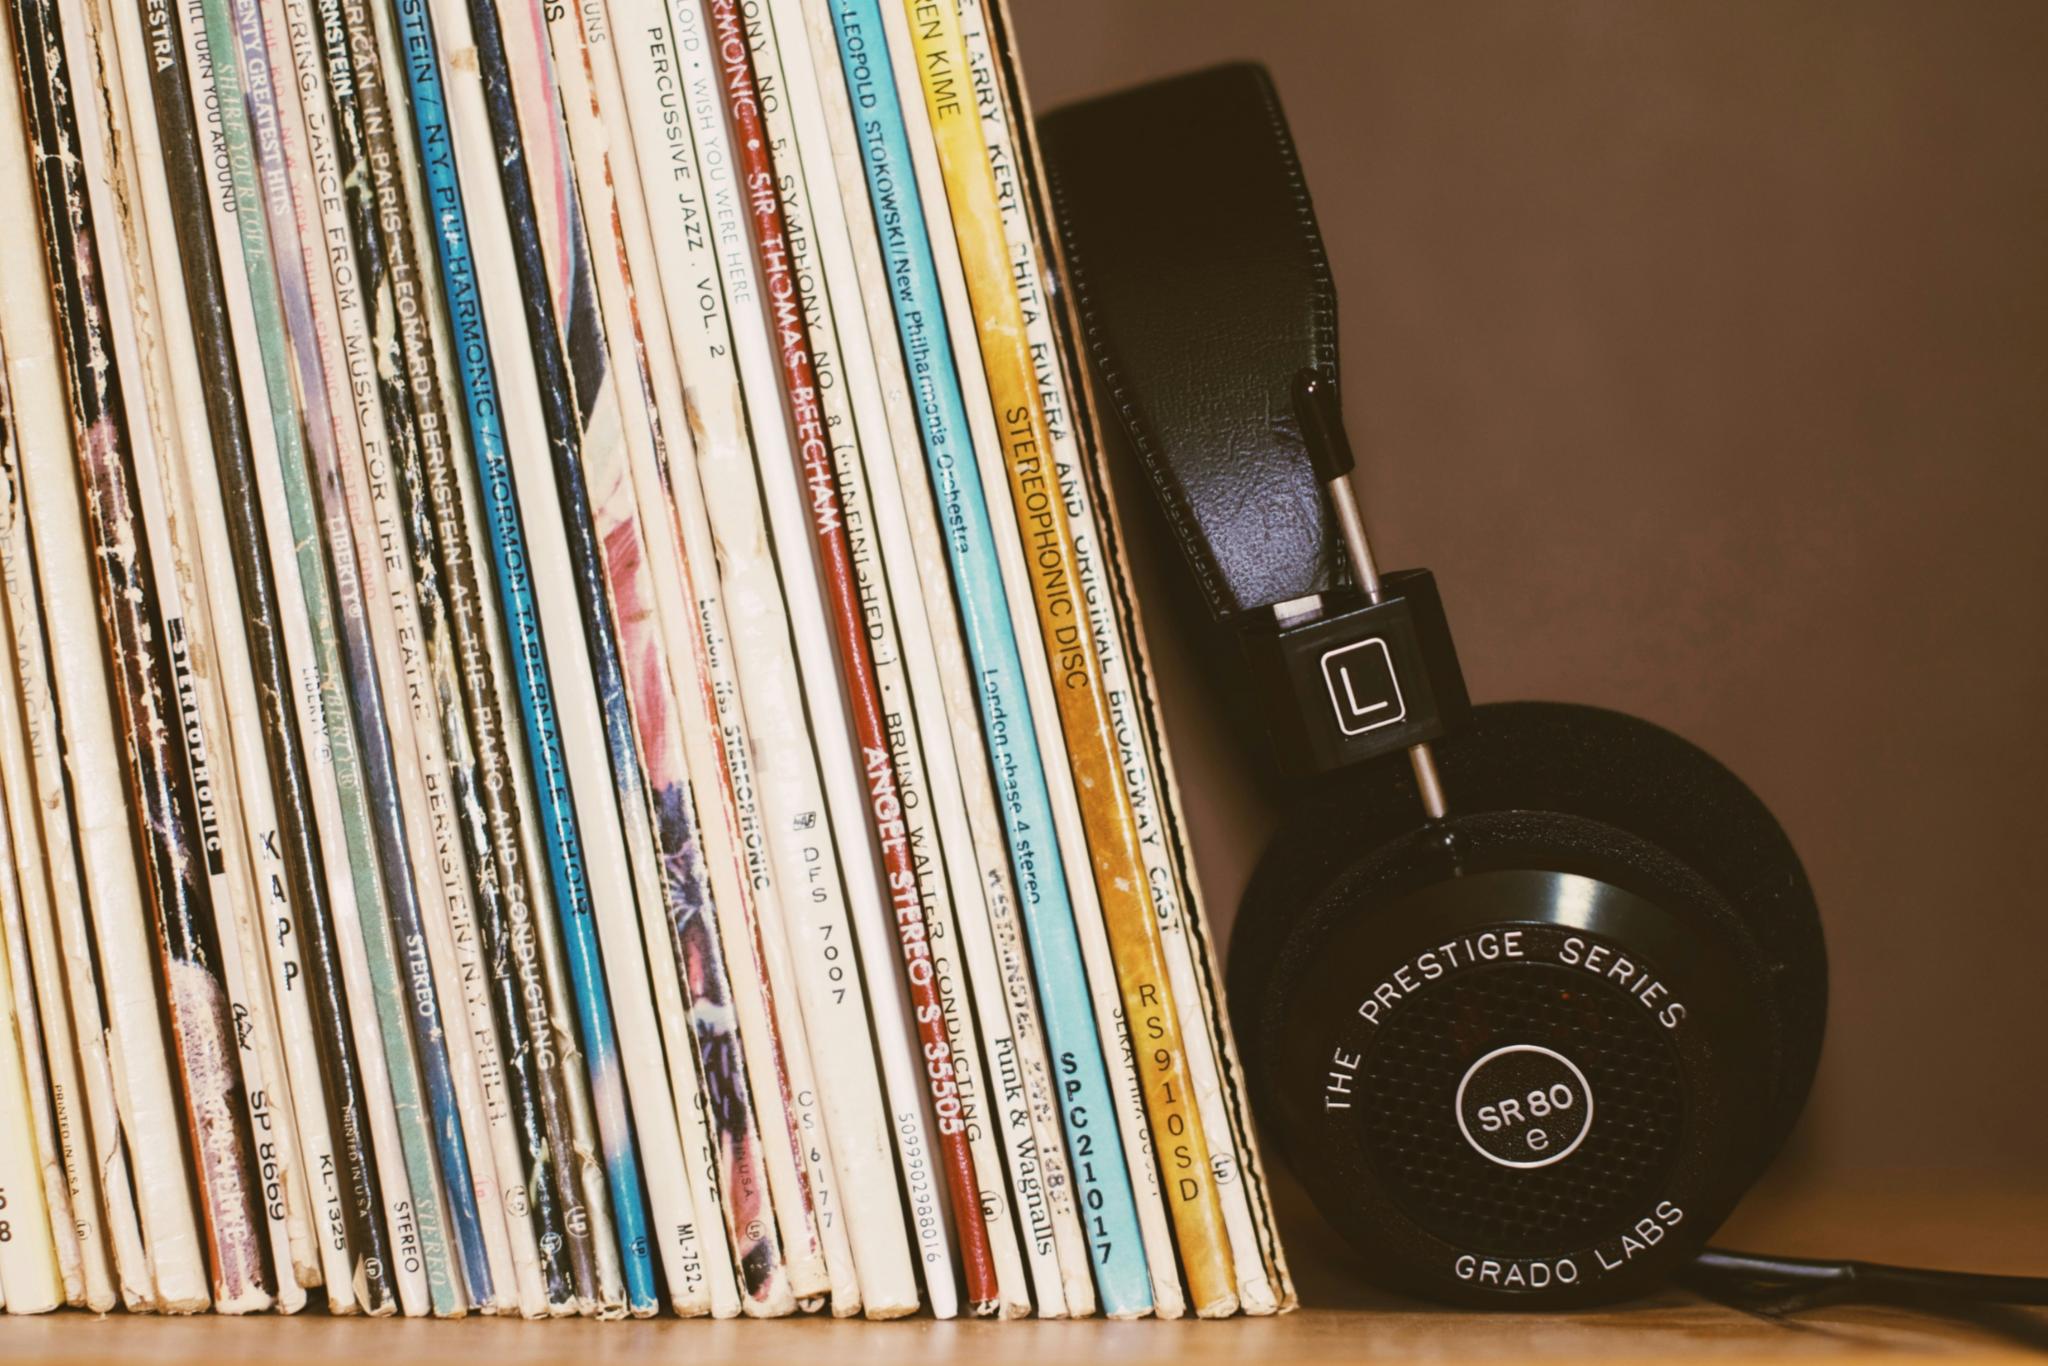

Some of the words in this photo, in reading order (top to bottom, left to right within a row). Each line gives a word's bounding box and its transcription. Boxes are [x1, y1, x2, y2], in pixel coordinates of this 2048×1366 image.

[192, 28, 213, 78] TURN
[922, 48, 963, 121] KIME
[201, 86, 221, 124] YOU
[246, 56, 282, 164] GREATEST
[266, 168, 291, 216] HITS
[361, 104, 384, 136] IN
[691, 77, 715, 130] WISH
[209, 129, 238, 214] AROUND
[646, 25, 692, 182] PERCUSSIVE
[678, 190, 705, 253] JAZZ
[708, 342, 725, 359] 2
[703, 136, 725, 183] YOU
[746, 170, 776, 216] SIR
[713, 187, 737, 244] WERE
[838, 9, 877, 111] LEOPOLD
[900, 309, 952, 446] Philharmonia
[306, 111, 340, 215] DANCE
[325, 227, 357, 310] FROM
[364, 439, 391, 501] FOR
[723, 250, 751, 305] HERE
[759, 232, 808, 368] THOMAS
[789, 384, 839, 535] BEECHAM
[960, 29, 1002, 127] LARRY
[1029, 340, 1068, 443] RIVERA
[1055, 457, 1085, 520] AND
[1072, 533, 1118, 675] ORIGINAL
[1106, 687, 1159, 850] BROADWAY
[418, 409, 463, 567] BERNSTEIN
[1002, 404, 1078, 620] STEREOPHONIC
[1052, 622, 1090, 691] DISC
[449, 579, 473, 620] AT
[458, 632, 487, 693] THE
[485, 454, 526, 595] MORMON
[513, 602, 568, 806] TABERNACLE
[554, 816, 588, 918] CHOIR
[774, 174, 823, 332] SYMPHONY
[824, 414, 842, 428] 8
[883, 710, 920, 811] BRUNO
[907, 825, 946, 941] WALTER
[933, 955, 983, 1143] CONDUCTING
[1340, 666, 1388, 715] L
[168, 636, 223, 853] STEREOPHONIC
[980, 667, 1013, 747] London
[860, 741, 908, 854] ANGEL
[994, 750, 1025, 815] phase
[490, 805, 518, 868] AND
[1011, 818, 1030, 834] 4
[817, 922, 849, 1005] 7007
[888, 868, 935, 988] STEREO
[403, 932, 438, 1018] STEREO
[503, 881, 556, 1071] CONDUCTING
[914, 1000, 942, 1025] S
[1325, 1047, 1361, 1111] THE
[1358, 931, 1524, 1024] PRESTIGE
[1558, 936, 1687, 1028] SERIES
[247, 1086, 272, 1133] SP
[921, 1038, 967, 1137] 35505
[992, 1035, 1024, 1102] Funk
[54, 1082, 71, 1140] PRINTED
[1008, 1106, 1030, 1129] &
[1526, 1128, 1549, 1151] e
[257, 1140, 286, 1222] 8669
[318, 1152, 347, 1252] KL-1325
[896, 1111, 942, 1264] 5099902988016
[1008, 1134, 1057, 1259] Wagnalls
[393, 1199, 420, 1274] STEREO
[674, 1222, 705, 1294] ML-752
[1455, 1255, 1578, 1287] GRADO
[1594, 1201, 1684, 1271] LABS
